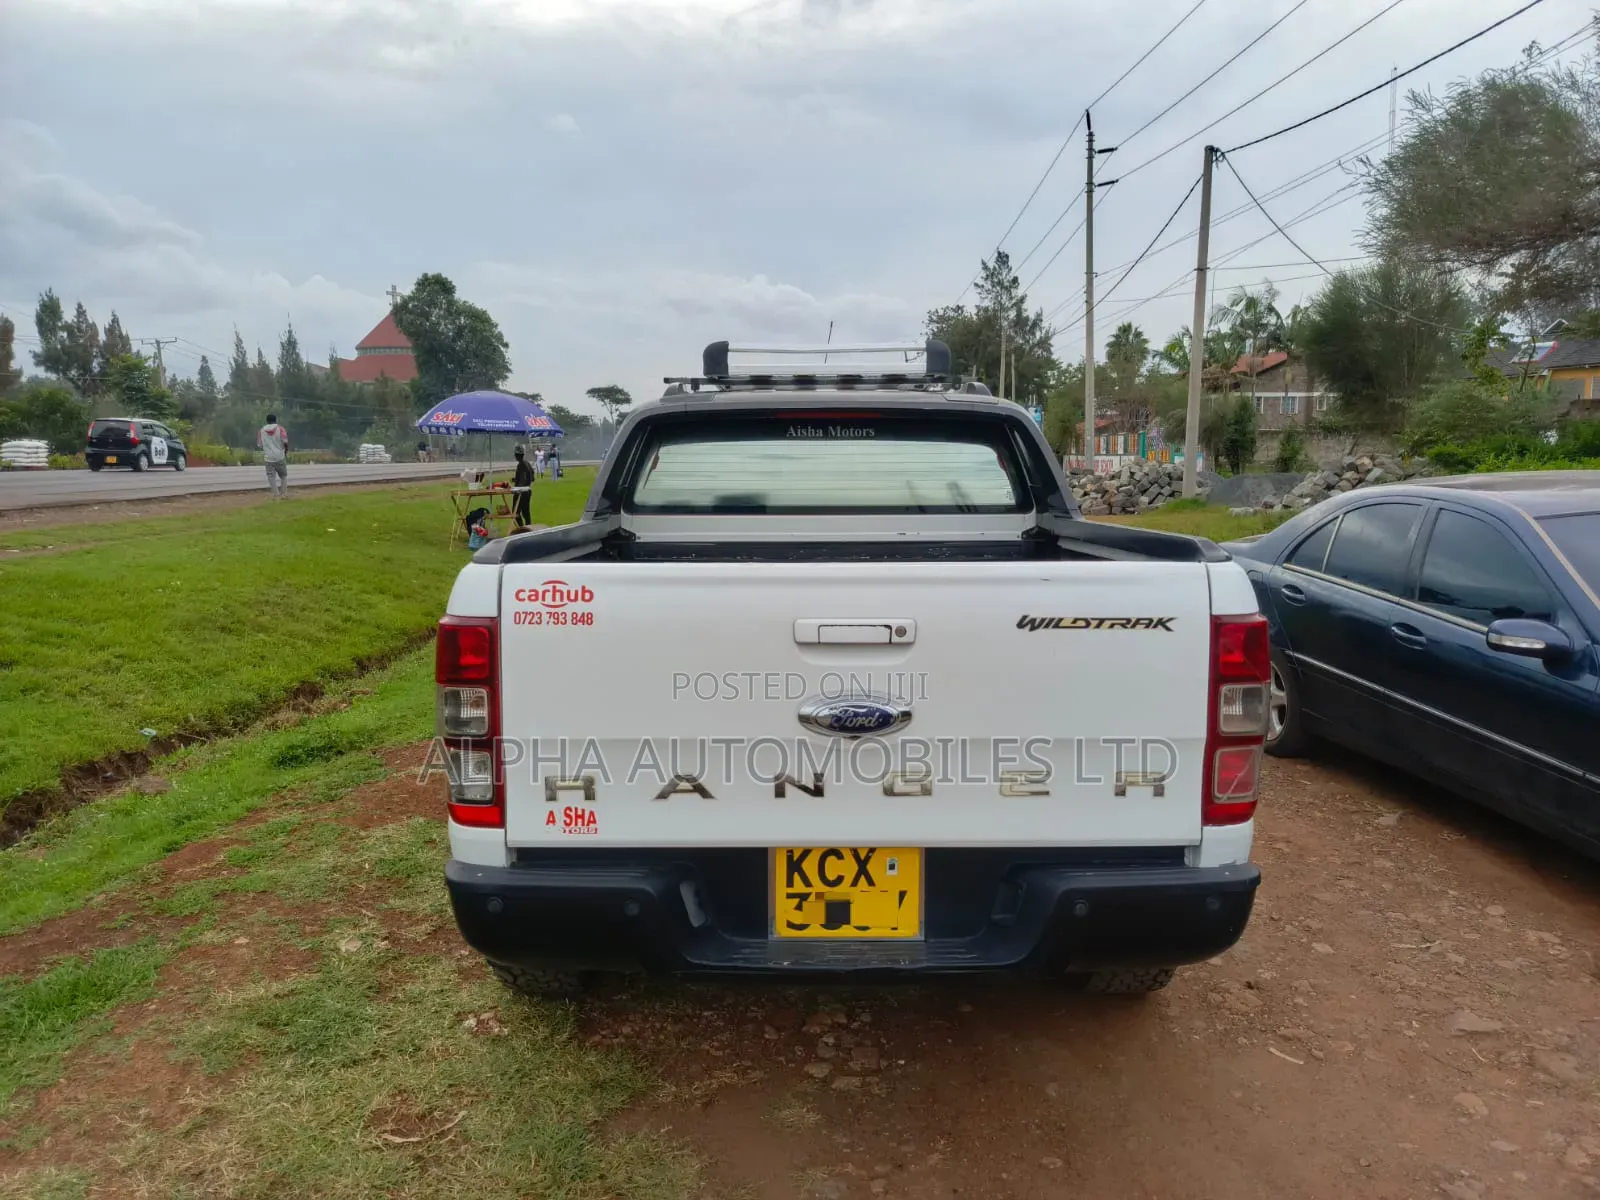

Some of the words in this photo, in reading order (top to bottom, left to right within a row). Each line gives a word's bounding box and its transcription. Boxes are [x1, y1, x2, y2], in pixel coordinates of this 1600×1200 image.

[786, 425, 823, 437] Aisha
[828, 425, 875, 437] Motors
[514, 585, 594, 603] carhub
[513, 611, 543, 626] 0723
[546, 611, 568, 626] 793
[571, 611, 594, 626] 848
[1016, 614, 1178, 632] WILDTRAK
[831, 706, 880, 729] Ford
[786, 847, 877, 888] KCX
